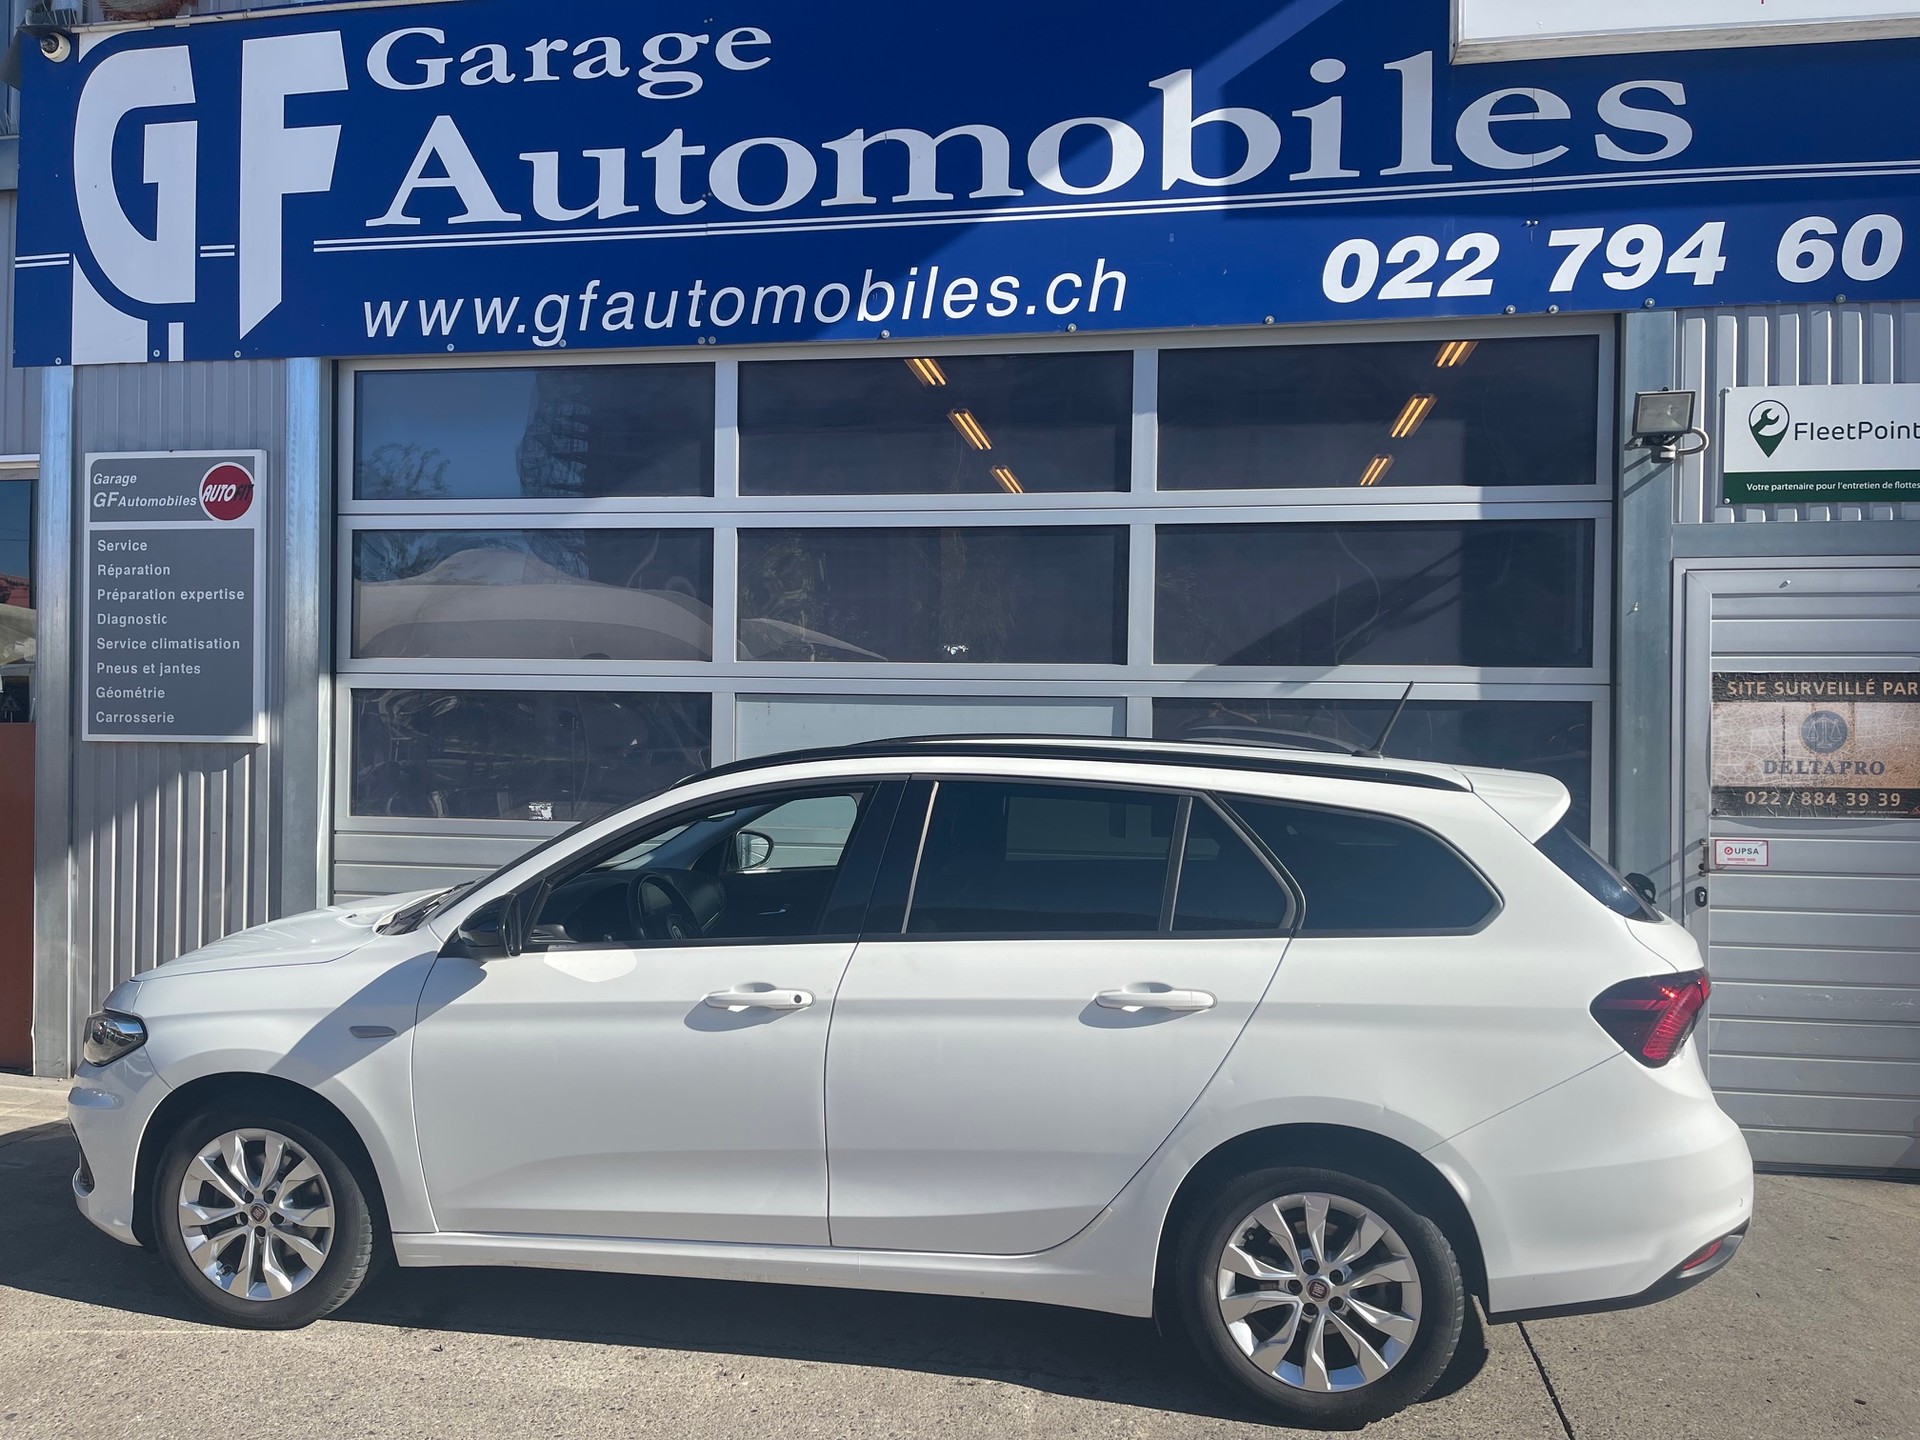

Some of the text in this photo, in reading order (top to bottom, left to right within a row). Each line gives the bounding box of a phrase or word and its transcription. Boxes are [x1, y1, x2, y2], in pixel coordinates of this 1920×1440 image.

[366, 26, 772, 100] Garage
[366, 50, 1693, 227] Automobiles
[74, 30, 348, 341] GF
[1322, 214, 1904, 304] 022 794 60
[364, 258, 1127, 347] www.gfautomobiles.ch
[93, 473, 137, 487] Garage
[1746, 482, 1770, 491] Votre
[1771, 482, 1814, 492] partenaire
[1815, 482, 1836, 491] pour
[1837, 481, 1880, 490] l'entretien
[1882, 481, 1893, 489] de
[97, 539, 148, 552] Service
[97, 564, 171, 577] Réparation
[97, 588, 245, 602] Préparation expertise
[97, 613, 168, 627] Diagnostic
[96, 637, 240, 650] Service climatisation
[96, 662, 201, 676] Pneus et jantes
[96, 686, 166, 699] Géométrie
[1727, 679, 1919, 695] SITE SURVEILLÉ PAR
[96, 710, 175, 723] Carrosserie
[1763, 760, 1886, 776] DELTAPRO
[1745, 791, 1781, 805] 022
[1801, 792, 1837, 806] 884
[1846, 792, 1869, 806] 39
[1878, 792, 1901, 807] 39
[1734, 847, 1759, 855] UPSA
